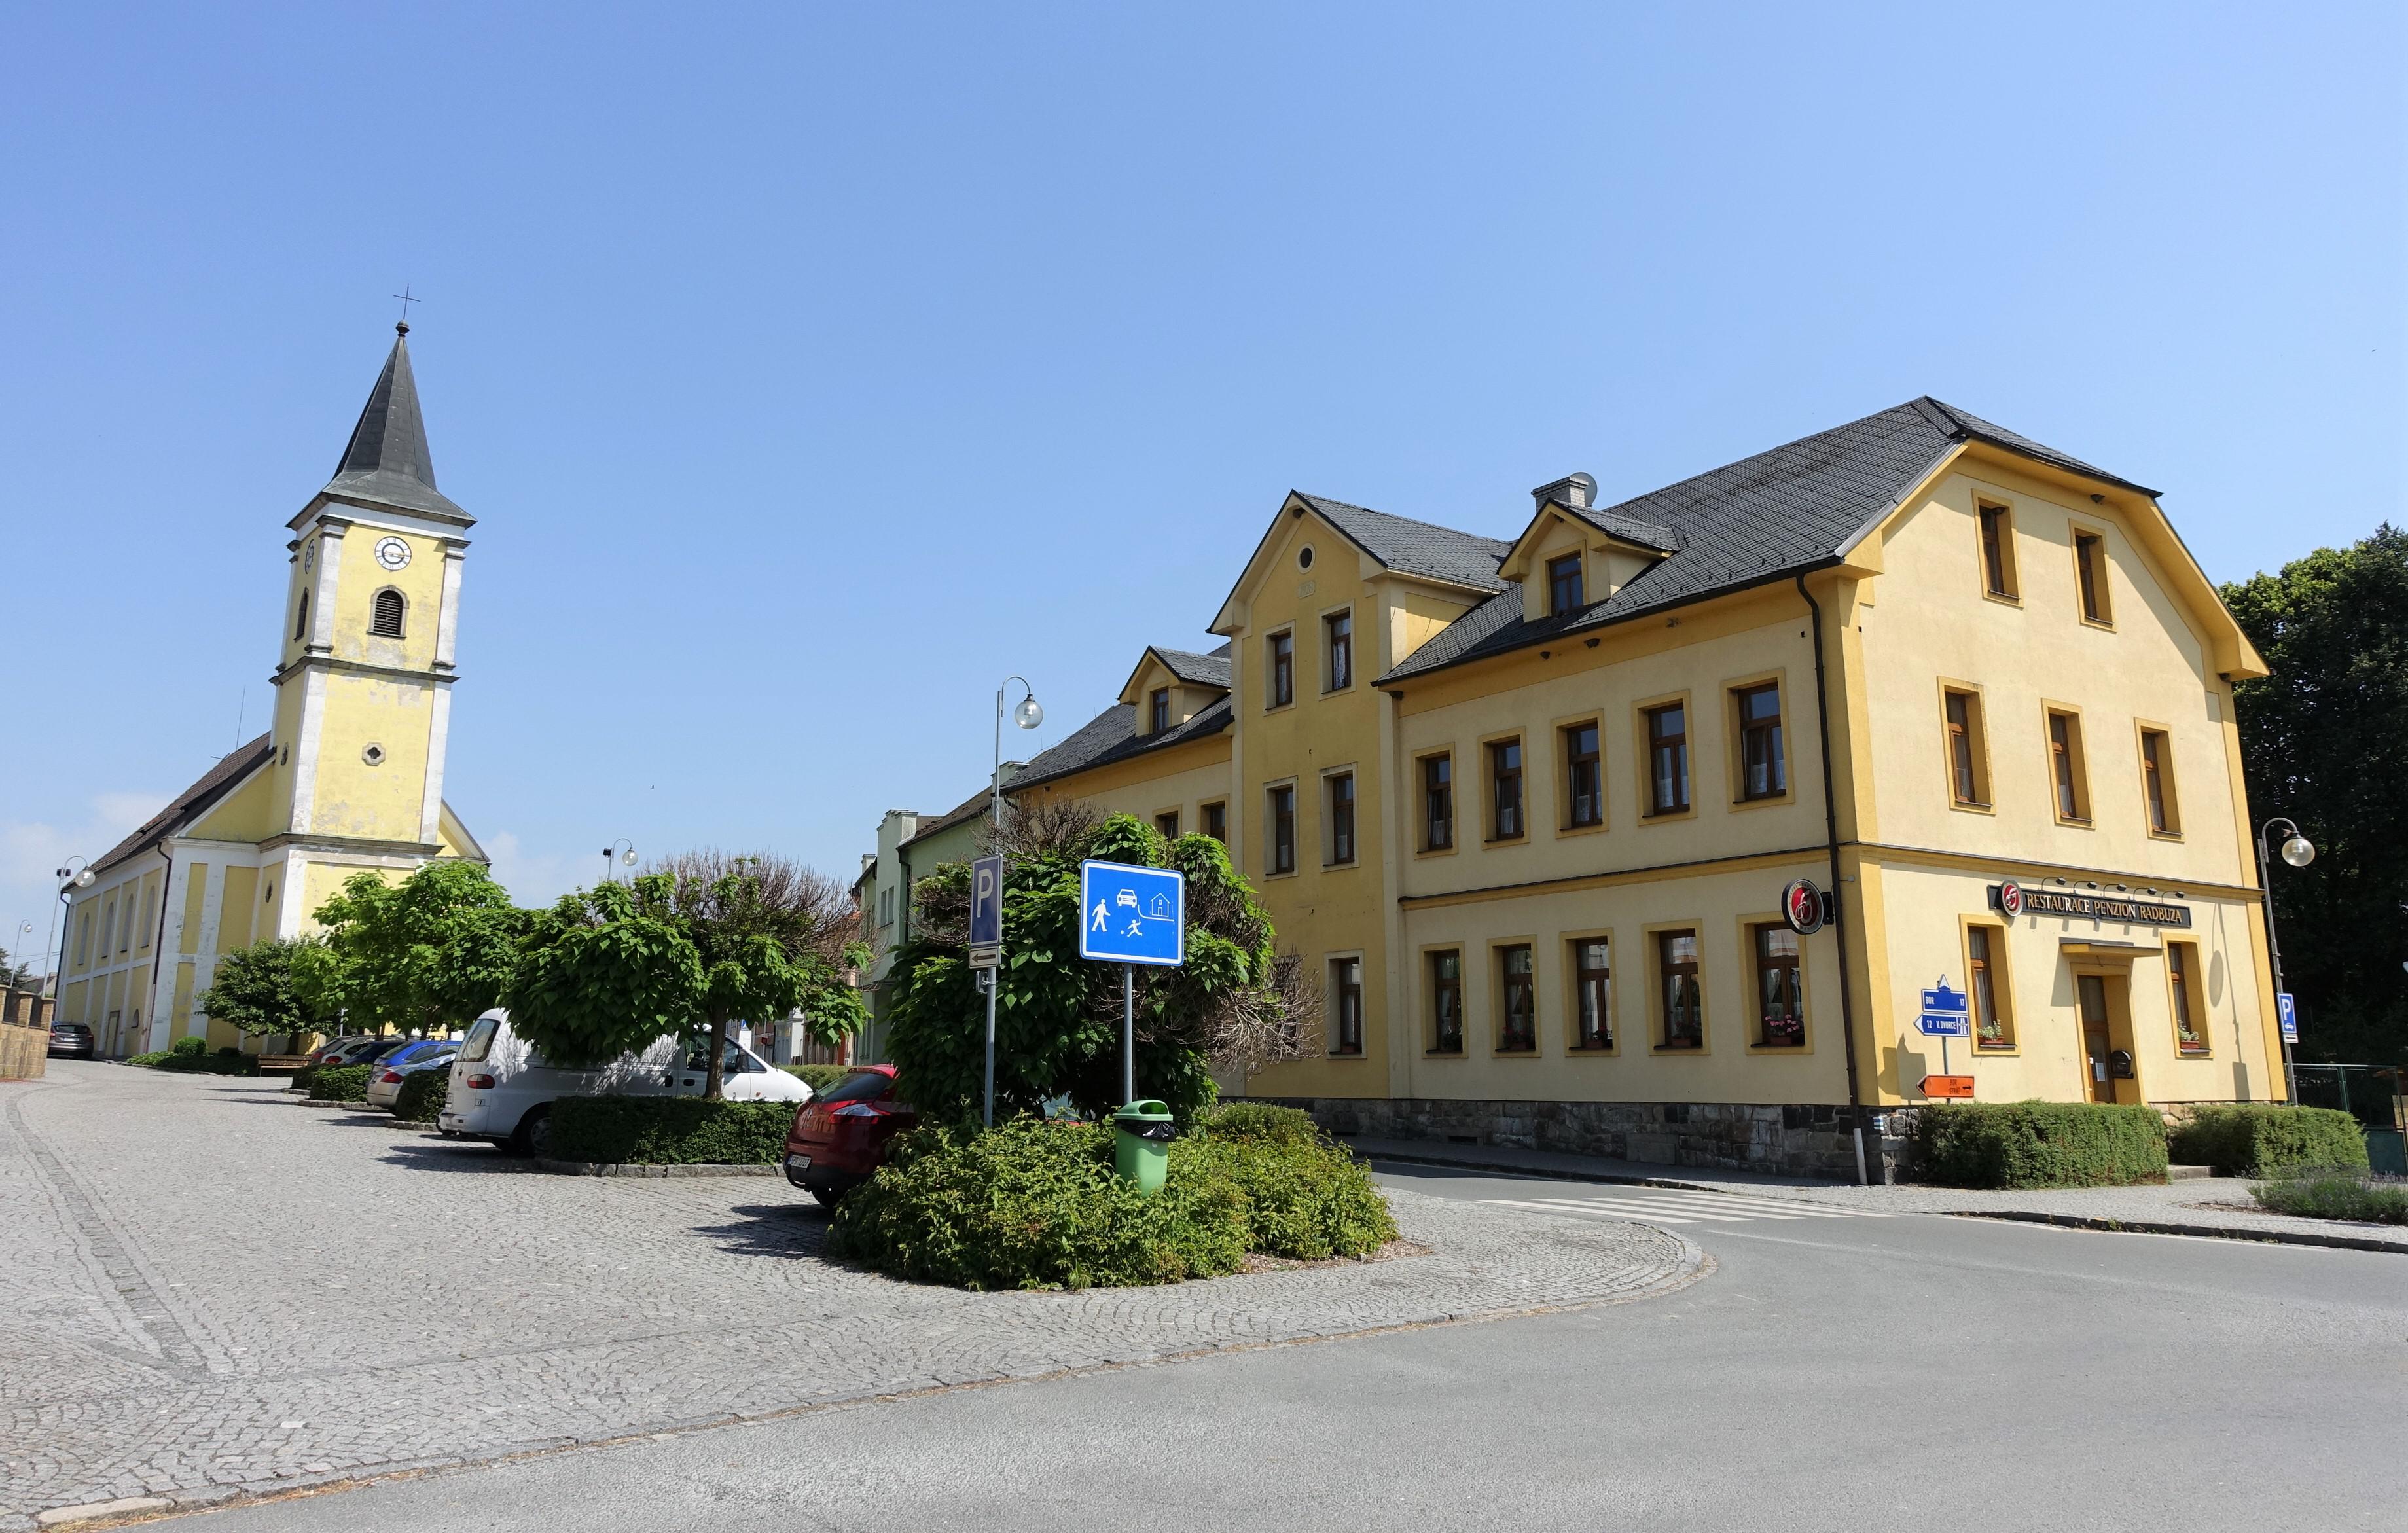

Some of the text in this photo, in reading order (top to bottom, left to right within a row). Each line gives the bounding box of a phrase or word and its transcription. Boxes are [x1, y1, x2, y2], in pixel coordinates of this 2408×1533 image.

[977, 869, 994, 918] P
[2026, 893, 2182, 923] RESTAURACE PENZION RADBUZA
[1925, 996, 1965, 1007] BOR 17
[2282, 998, 2291, 1021] P
[1926, 1020, 1933, 1029] 12
